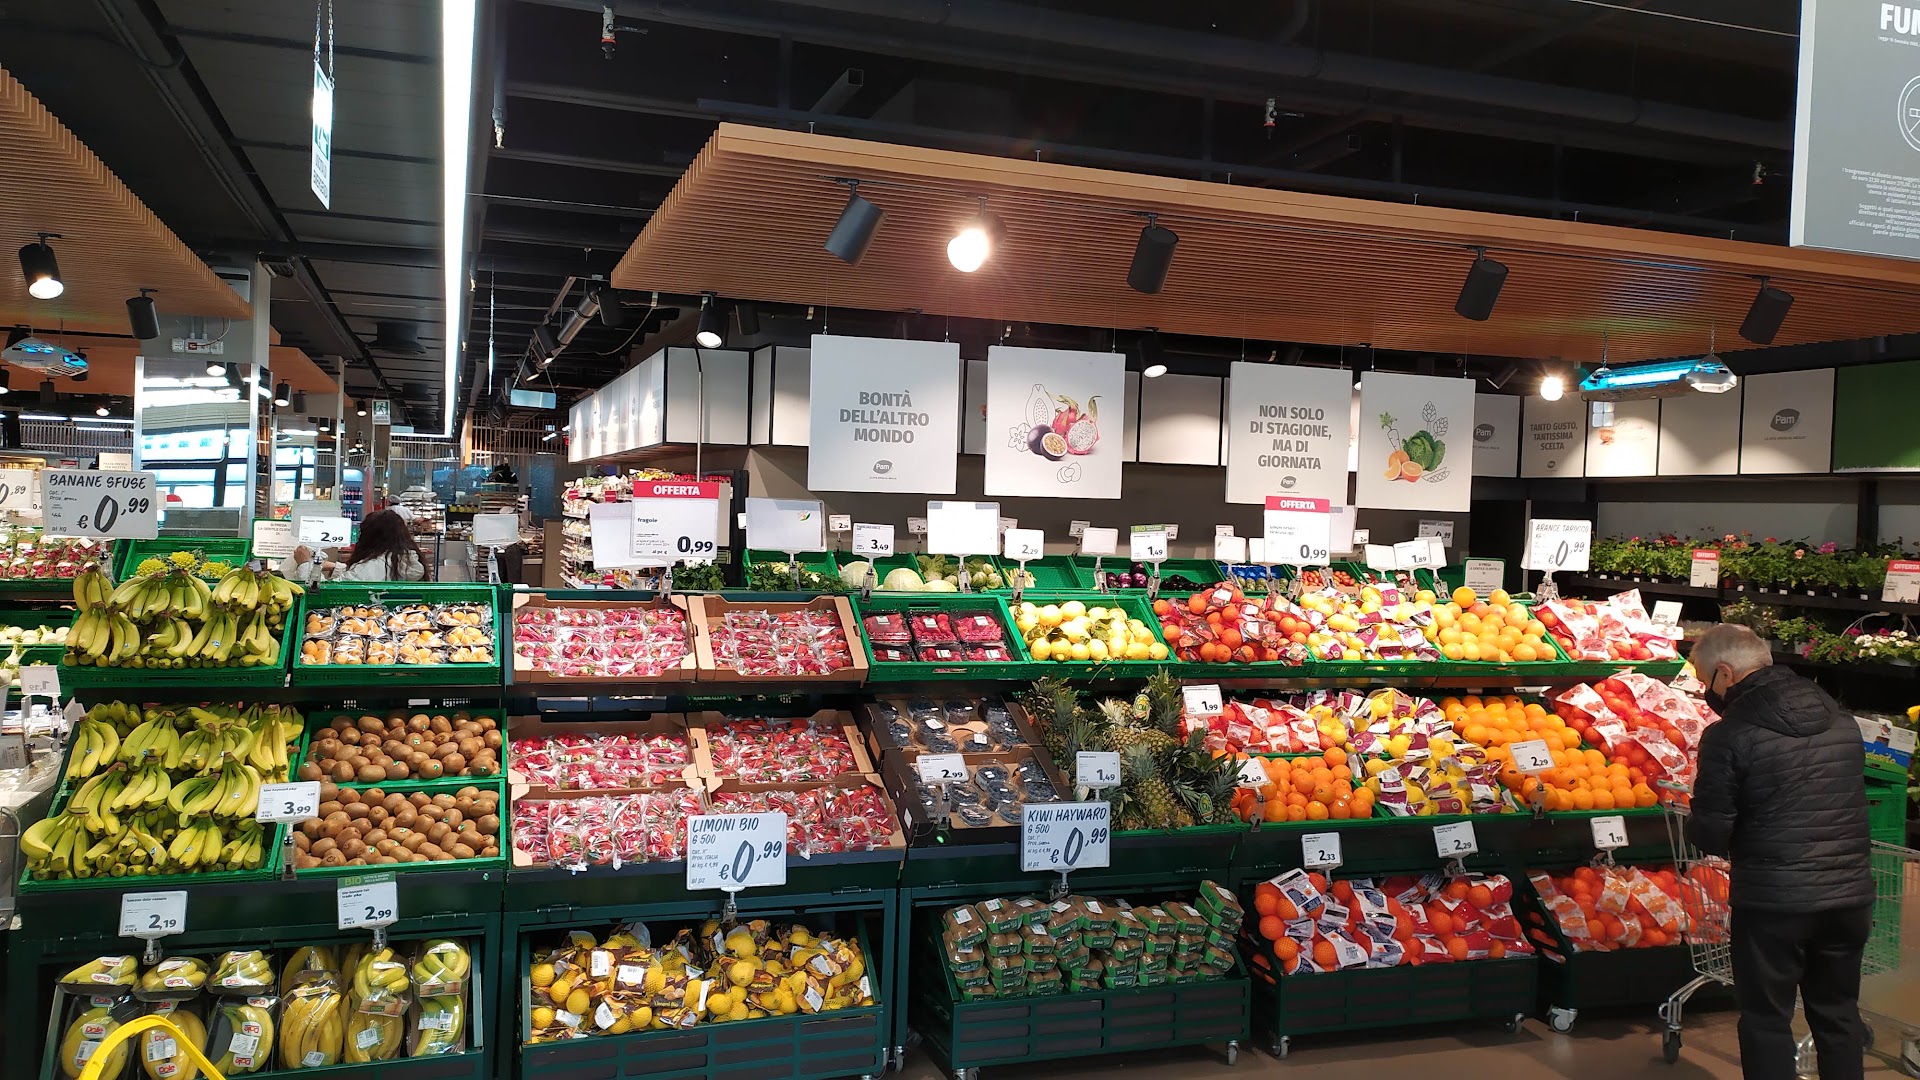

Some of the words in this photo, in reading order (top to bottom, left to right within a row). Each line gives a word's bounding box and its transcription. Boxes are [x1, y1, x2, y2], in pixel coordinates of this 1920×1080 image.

[859, 389, 912, 407] BONTÀ
[839, 409, 930, 426] DELL'ALTRO
[1259, 404, 1287, 418] NON
[1290, 407, 1325, 421] SOLO
[1775, 414, 1795, 424] Pam
[1249, 420, 1264, 434] DI
[1266, 422, 1332, 441] STAGIONE,
[1530, 423, 1552, 432] TANTO
[1552, 421, 1578, 432] GUSTO,
[854, 428, 915, 443] MONDO
[1475, 429, 1492, 437] Pam
[1533, 431, 1573, 441] TANTISSIMA
[1272, 439, 1293, 452] MA
[1295, 440, 1309, 453] DI
[1540, 442, 1564, 451] SCELTA
[1257, 454, 1322, 470] GIORNATA
[49, 474, 102, 488] BANANE
[106, 476, 147, 490] SFUSE
[653, 485, 701, 496] OFFERTA
[1280, 499, 1316, 510] OFFERTA
[76, 514, 89, 529] €
[94, 494, 149, 533] 0,99
[1535, 524, 1560, 532] ARANCE
[1562, 525, 1589, 533] TAROCCO
[321, 532, 344, 543] 2,99
[677, 535, 714, 555] 0,99
[870, 539, 889, 551] 3,49
[1021, 544, 1039, 555] 2,29
[1147, 546, 1163, 557] 1,49
[1299, 544, 1328, 560] 0,99
[1555, 540, 1585, 567] 0,99
[1202, 701, 1218, 712] 1,99
[1530, 756, 1549, 767] 2,29
[941, 769, 963, 779] 2,99
[1096, 769, 1115, 782] 1,49
[283, 801, 311, 816] 3,99
[1028, 809, 1053, 822] KIWI
[1055, 807, 1107, 822] HAYWARD
[692, 819, 736, 832] LIMONI
[739, 817, 760, 831] BIO
[1035, 823, 1050, 834] 500
[700, 834, 716, 844] 500
[1609, 832, 1624, 843] 1,19
[1049, 848, 1059, 863] €
[1063, 827, 1108, 866] 0,99
[1454, 839, 1472, 851] 2,29
[719, 863, 730, 880] €
[732, 840, 783, 883] 0,99
[1318, 849, 1336, 862] 2,33
[345, 877, 362, 886] BIO
[364, 905, 392, 920] 2,99
[148, 914, 177, 930] 2,19
[85, 1026, 104, 1034] Dole
[244, 1024, 260, 1034] Dole
[235, 1057, 251, 1066] Dole
[158, 1065, 175, 1074] Dole
